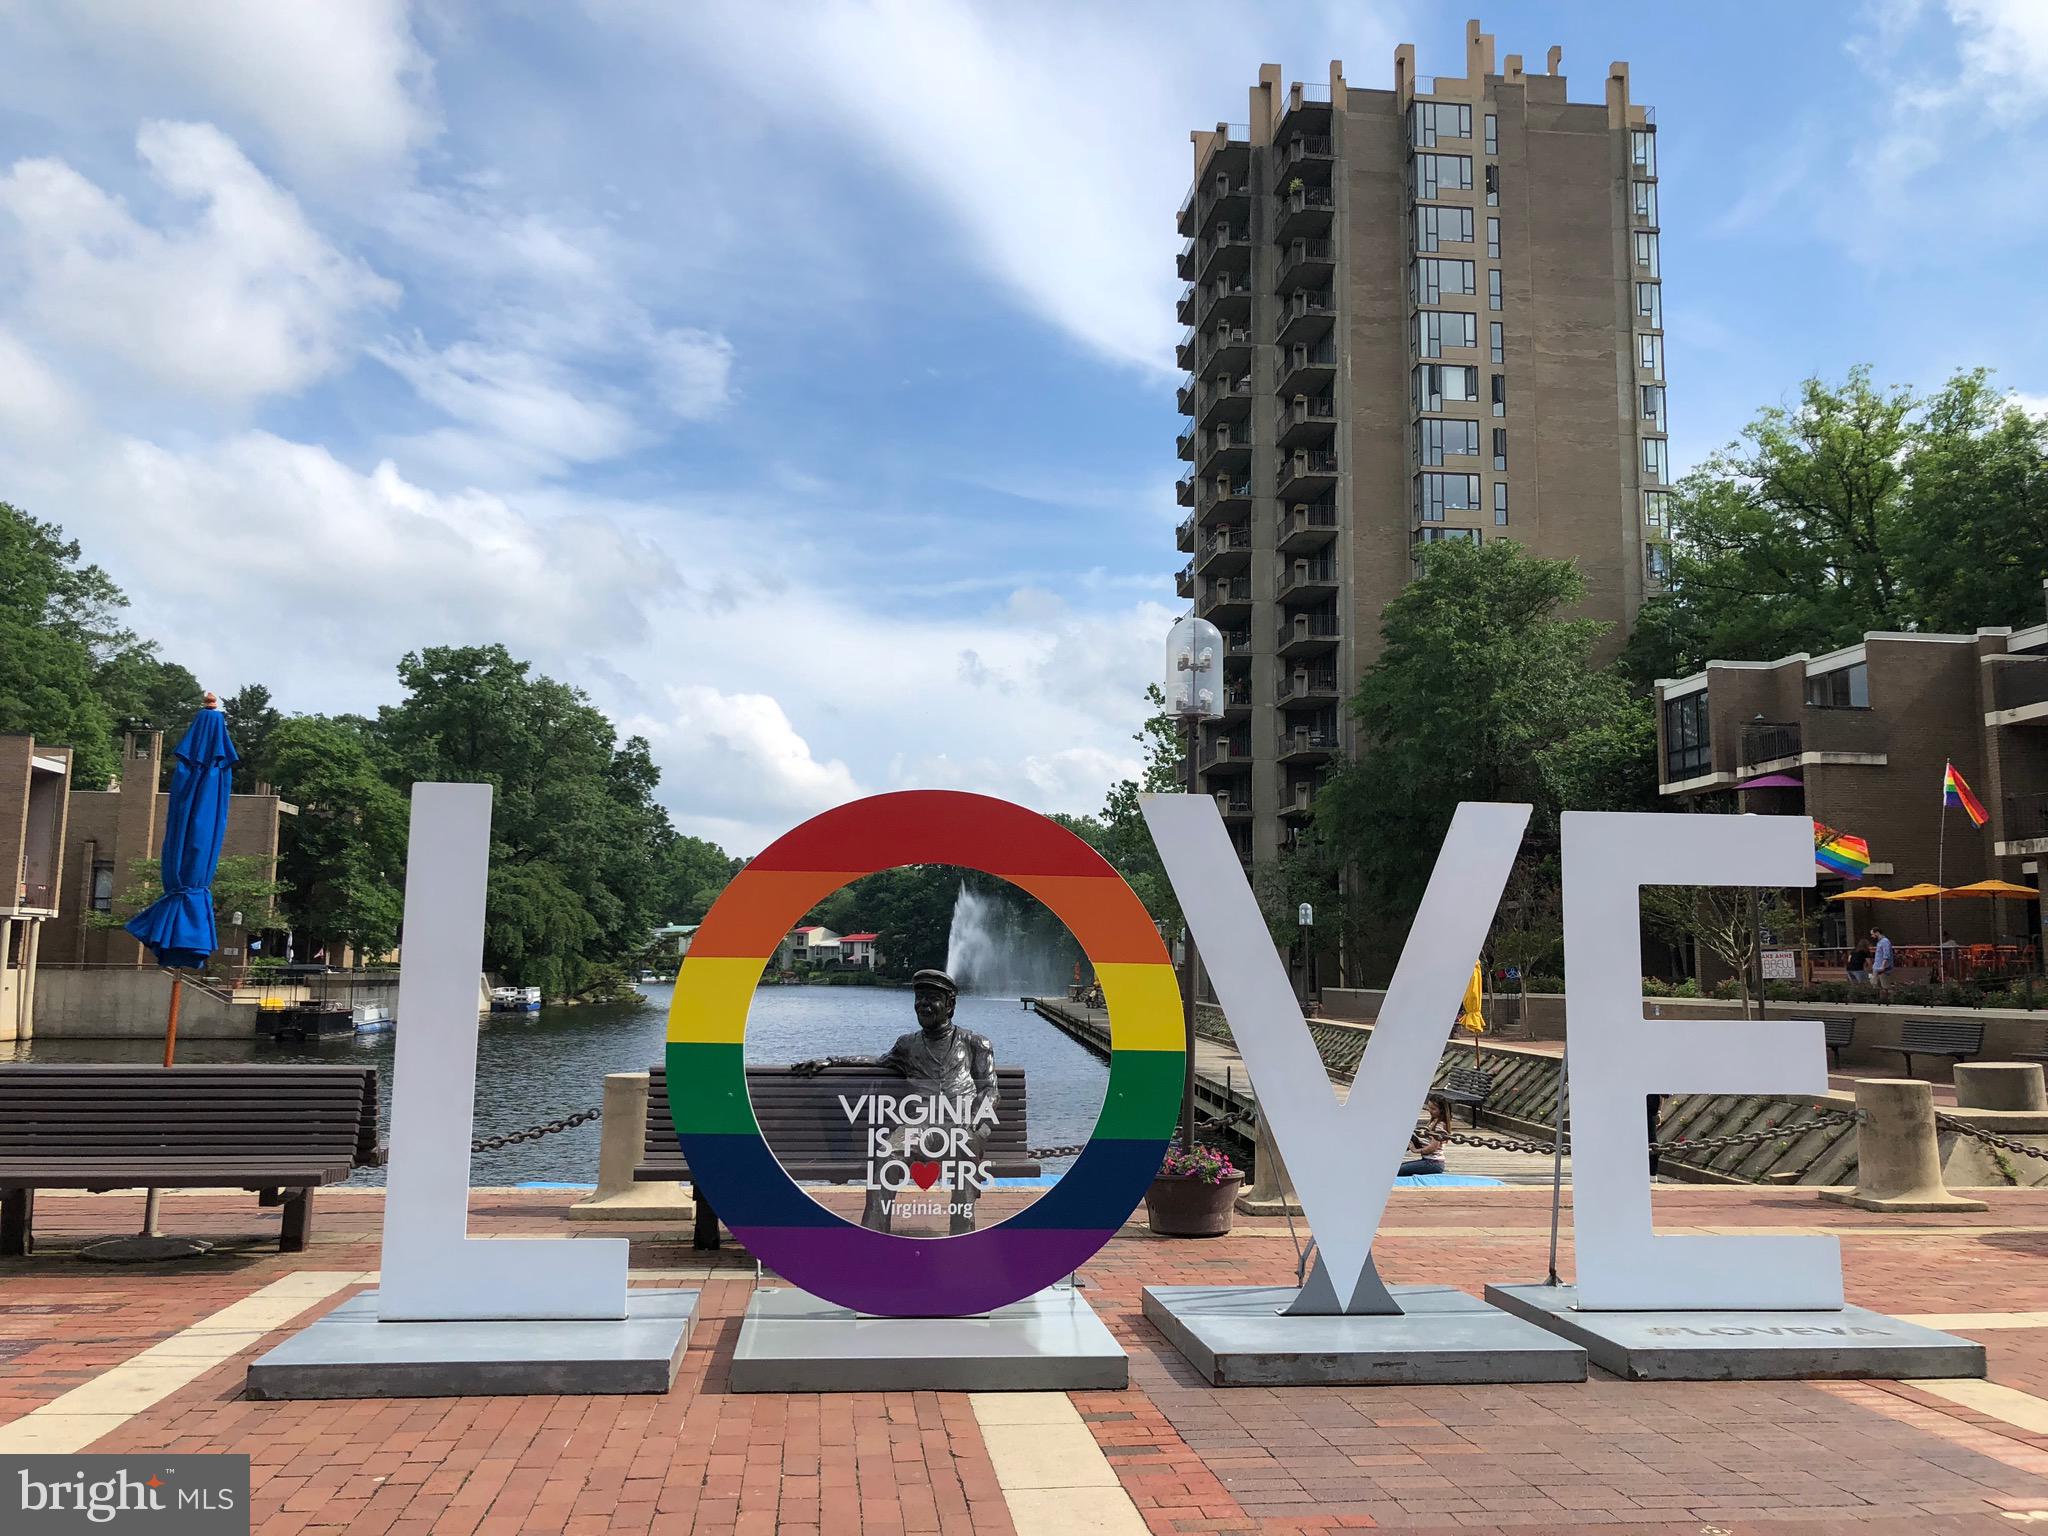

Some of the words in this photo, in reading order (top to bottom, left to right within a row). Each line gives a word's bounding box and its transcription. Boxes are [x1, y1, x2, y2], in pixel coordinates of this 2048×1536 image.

[1763, 959, 1793, 969] BREW
[380, 781, 1843, 1321] LOVE
[838, 1094, 1000, 1125] VIRGINIA
[867, 1127, 893, 1158] IS
[903, 1127, 976, 1158] FOR
[867, 1160, 995, 1192] LOERS
[881, 1200, 973, 1219] Virginia.org
